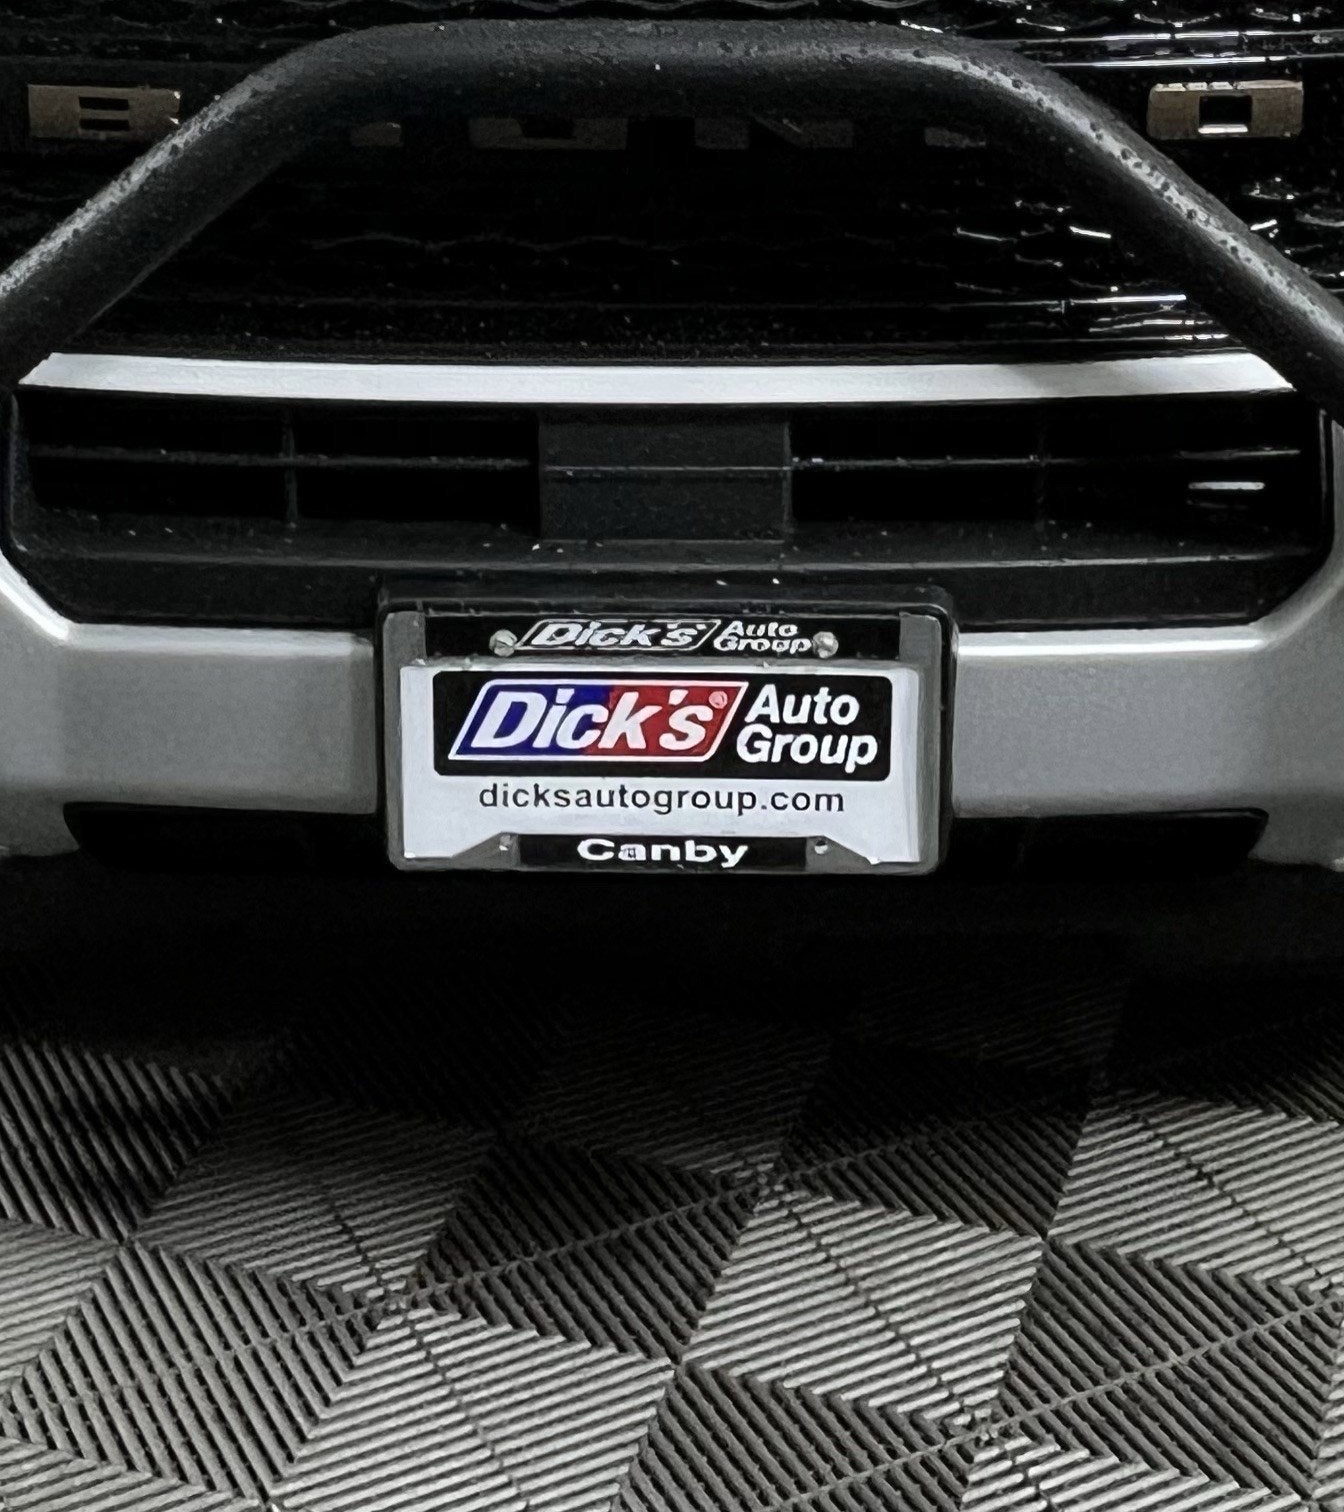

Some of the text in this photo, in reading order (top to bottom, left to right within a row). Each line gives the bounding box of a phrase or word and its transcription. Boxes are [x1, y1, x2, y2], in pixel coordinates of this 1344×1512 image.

[724, 620, 799, 637] Auto
[713, 635, 813, 654] Group
[745, 684, 860, 727] Auto
[736, 724, 879, 774] Group
[478, 783, 845, 816] dicksautogroup.com
[576, 838, 749, 868] Canby
